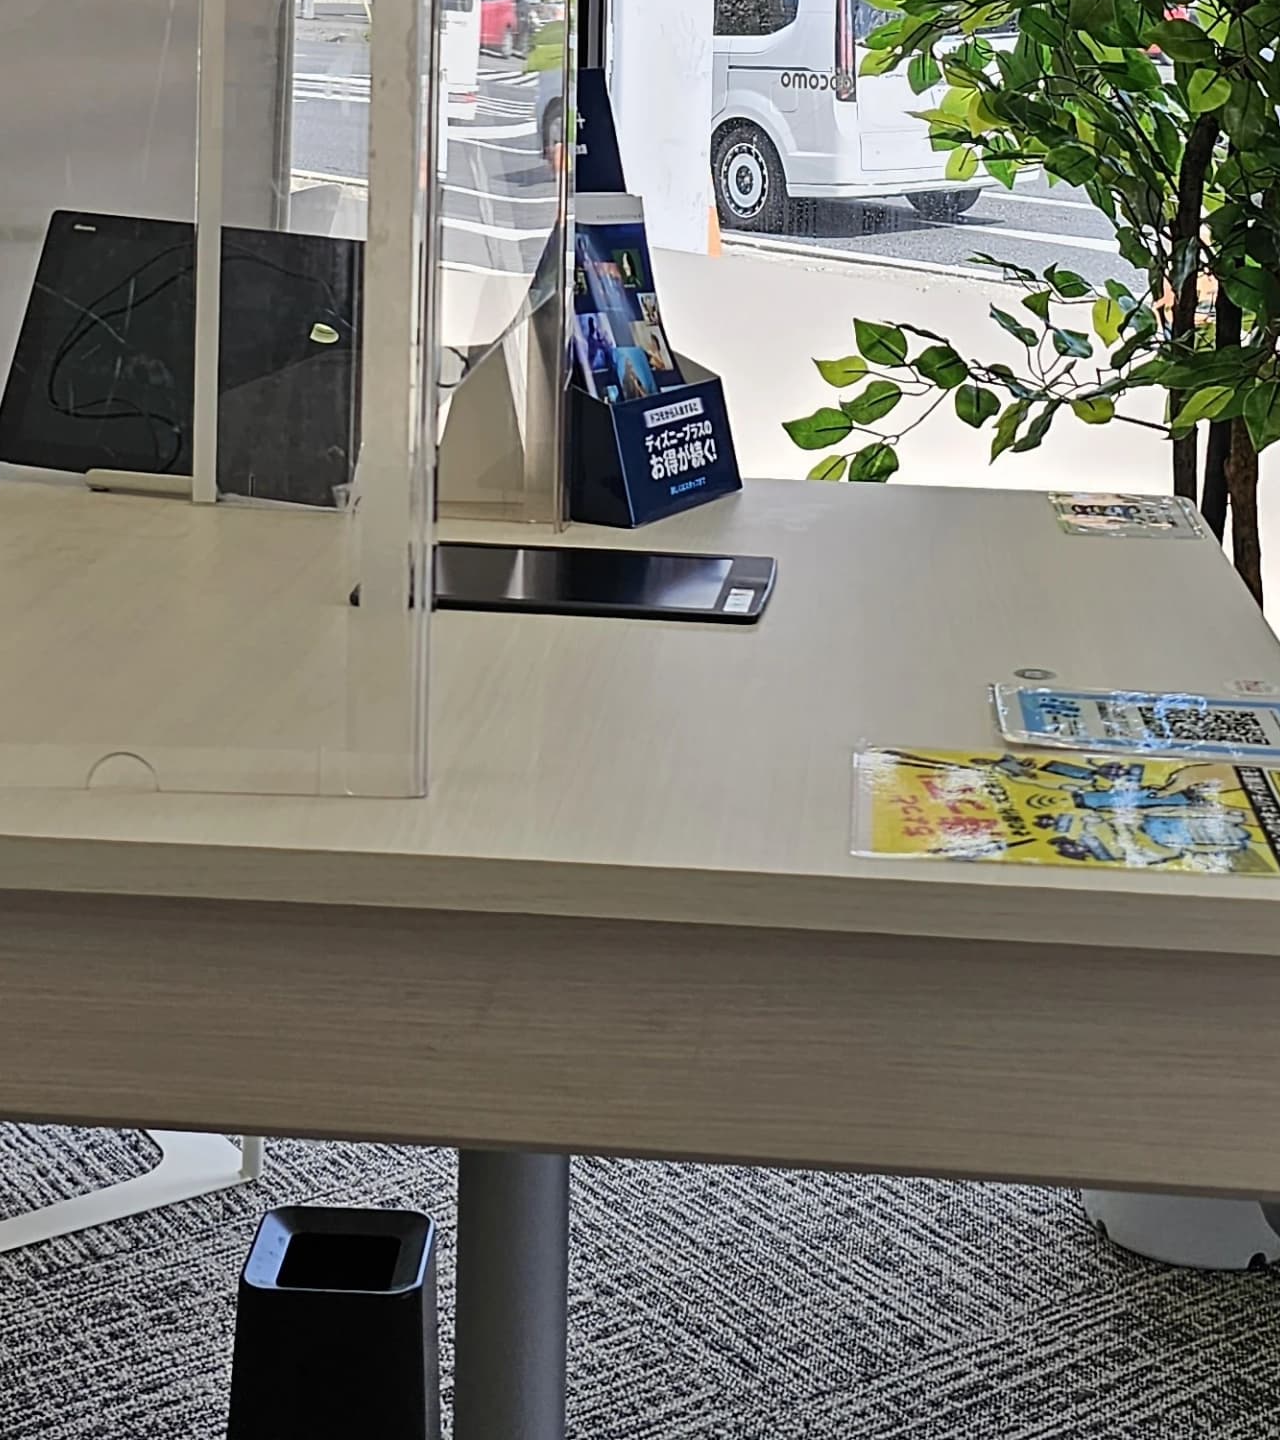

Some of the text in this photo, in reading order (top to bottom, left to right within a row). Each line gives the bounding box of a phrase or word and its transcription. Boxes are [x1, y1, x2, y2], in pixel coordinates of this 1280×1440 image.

[644, 420, 713, 454] ディズニープラスの
[649, 437, 718, 481] お得が続く!
